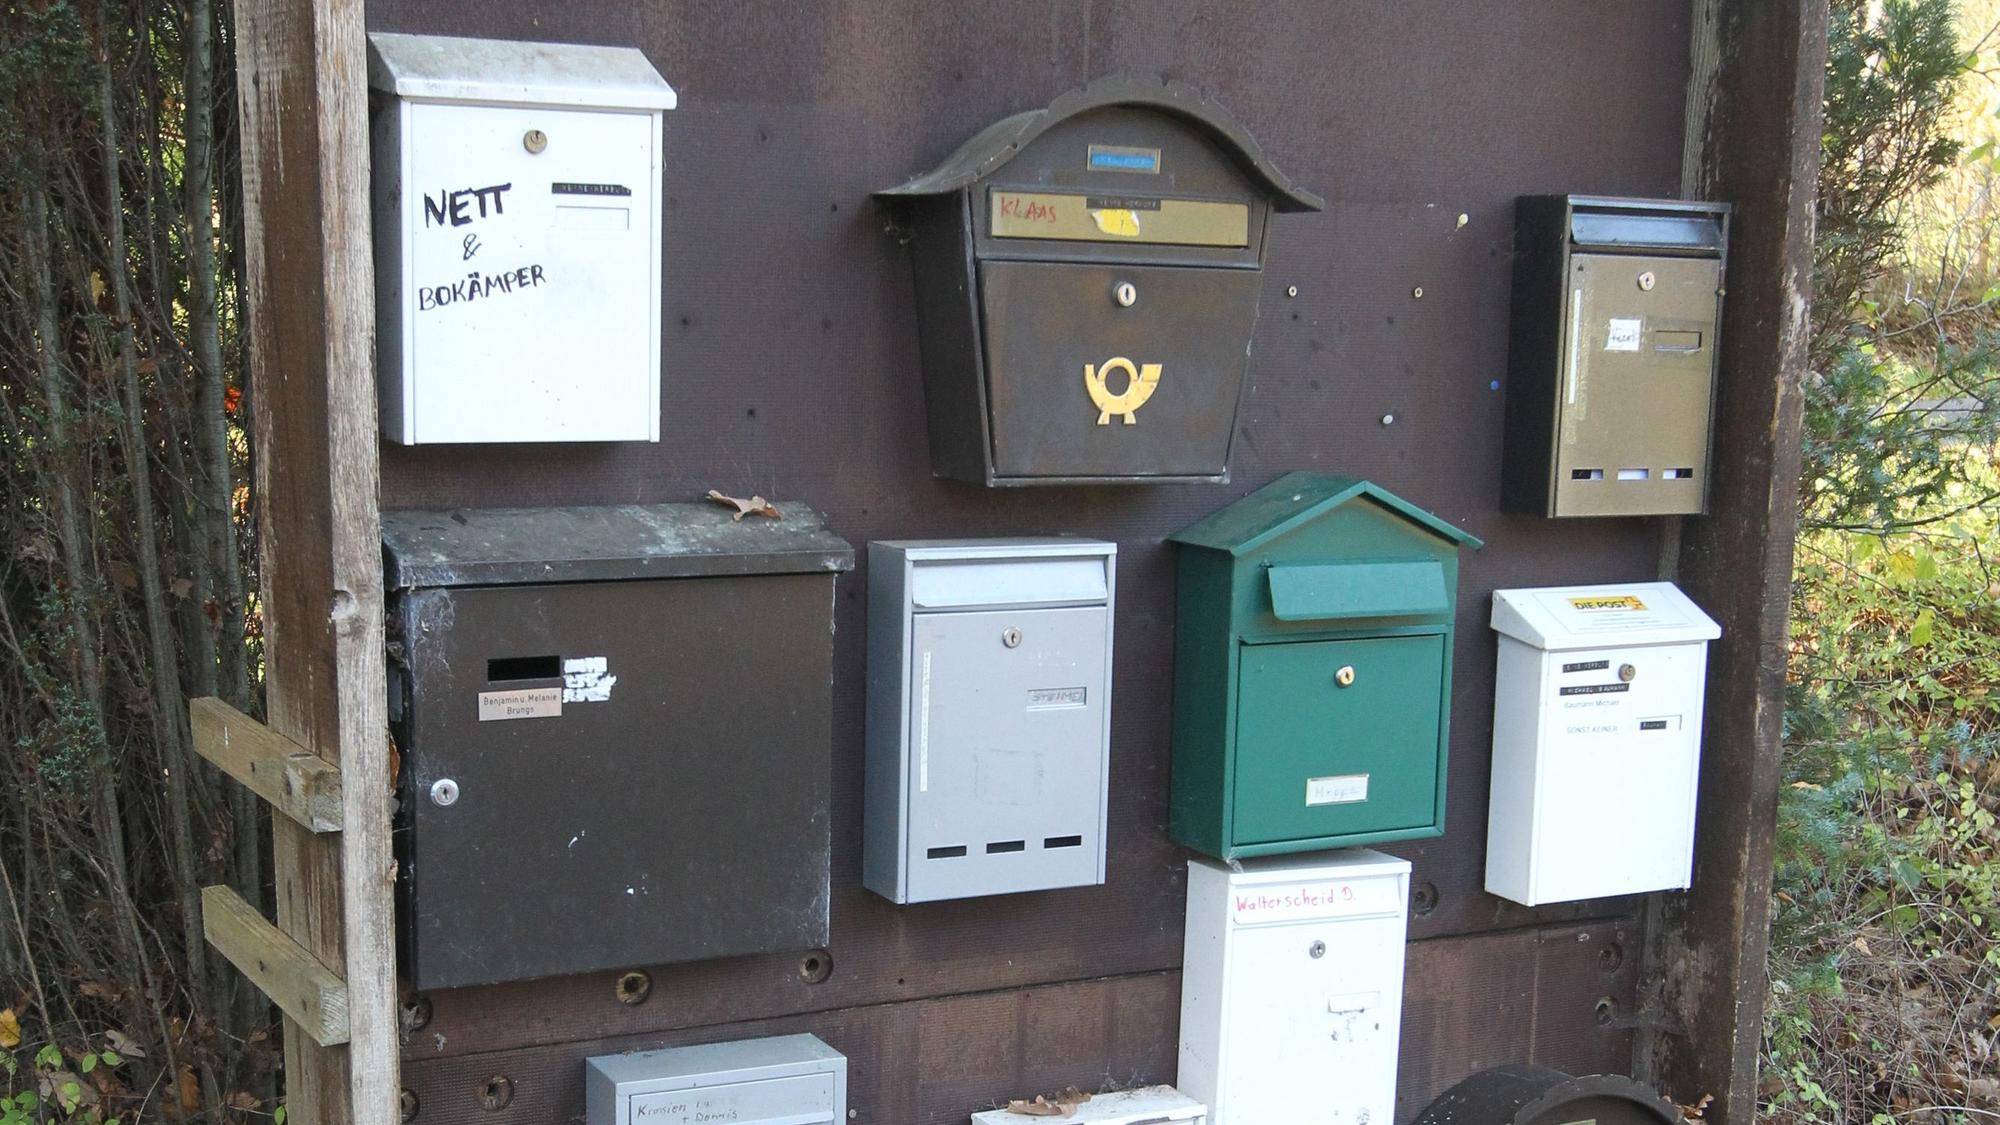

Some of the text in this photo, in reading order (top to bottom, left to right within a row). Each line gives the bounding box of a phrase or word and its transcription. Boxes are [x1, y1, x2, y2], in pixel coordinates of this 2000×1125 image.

[424, 182, 511, 228] NETT
[463, 233, 482, 260] &
[419, 265, 546, 310] BOKÄMPER
[1574, 600, 1627, 610] DIE POST
[483, 695, 520, 706] Benjamin
[528, 694, 557, 703] Melanie
[507, 706, 534, 715] Brungs
[1236, 888, 1334, 912] Walterscheid
